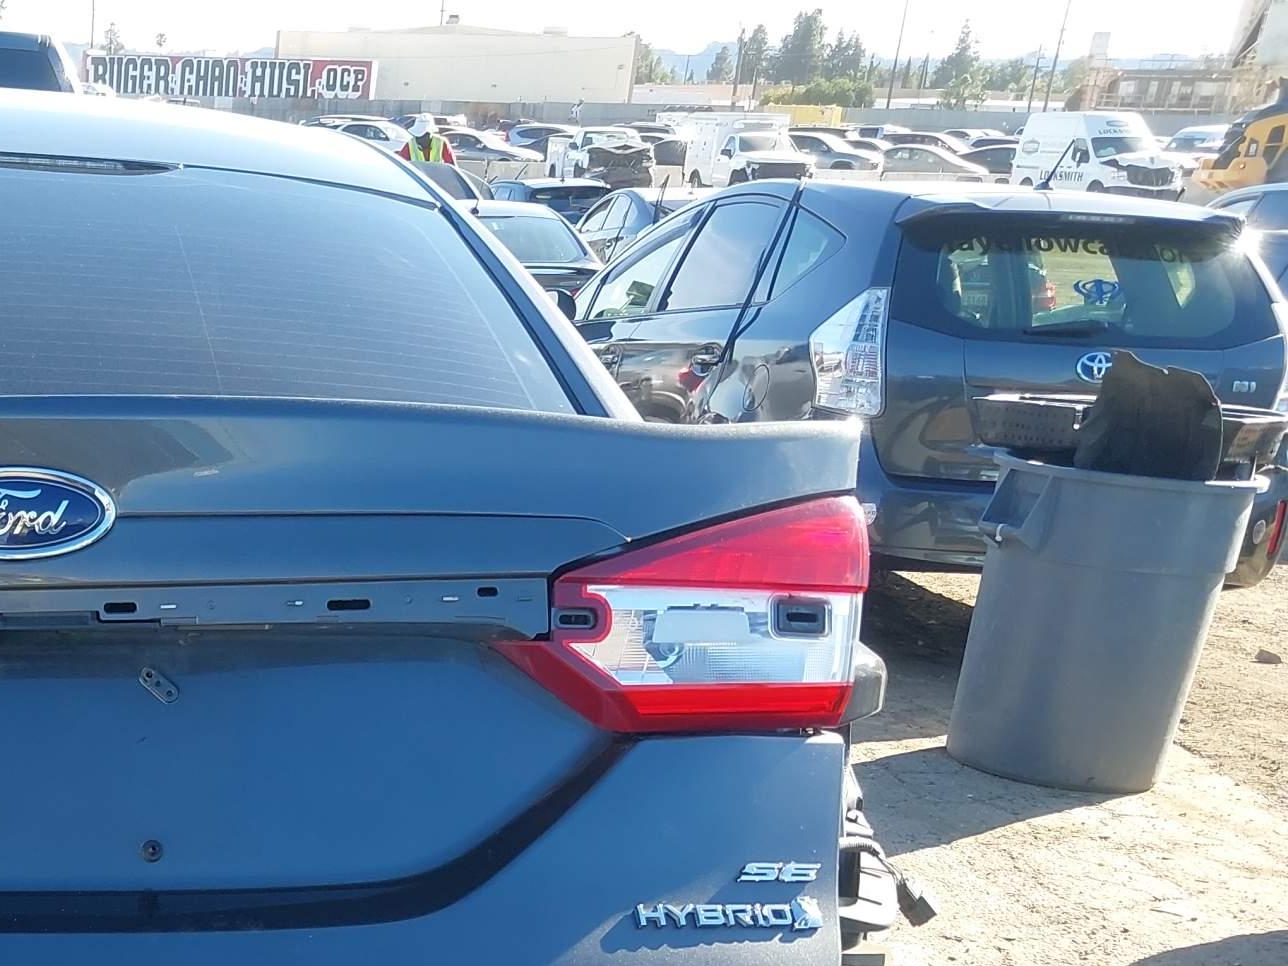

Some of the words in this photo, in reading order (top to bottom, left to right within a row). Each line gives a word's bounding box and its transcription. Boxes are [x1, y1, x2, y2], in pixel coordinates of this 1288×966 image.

[1039, 169, 1083, 182] LOKSMITH
[736, 861, 821, 882] SE
[634, 902, 792, 928] HYBRID
